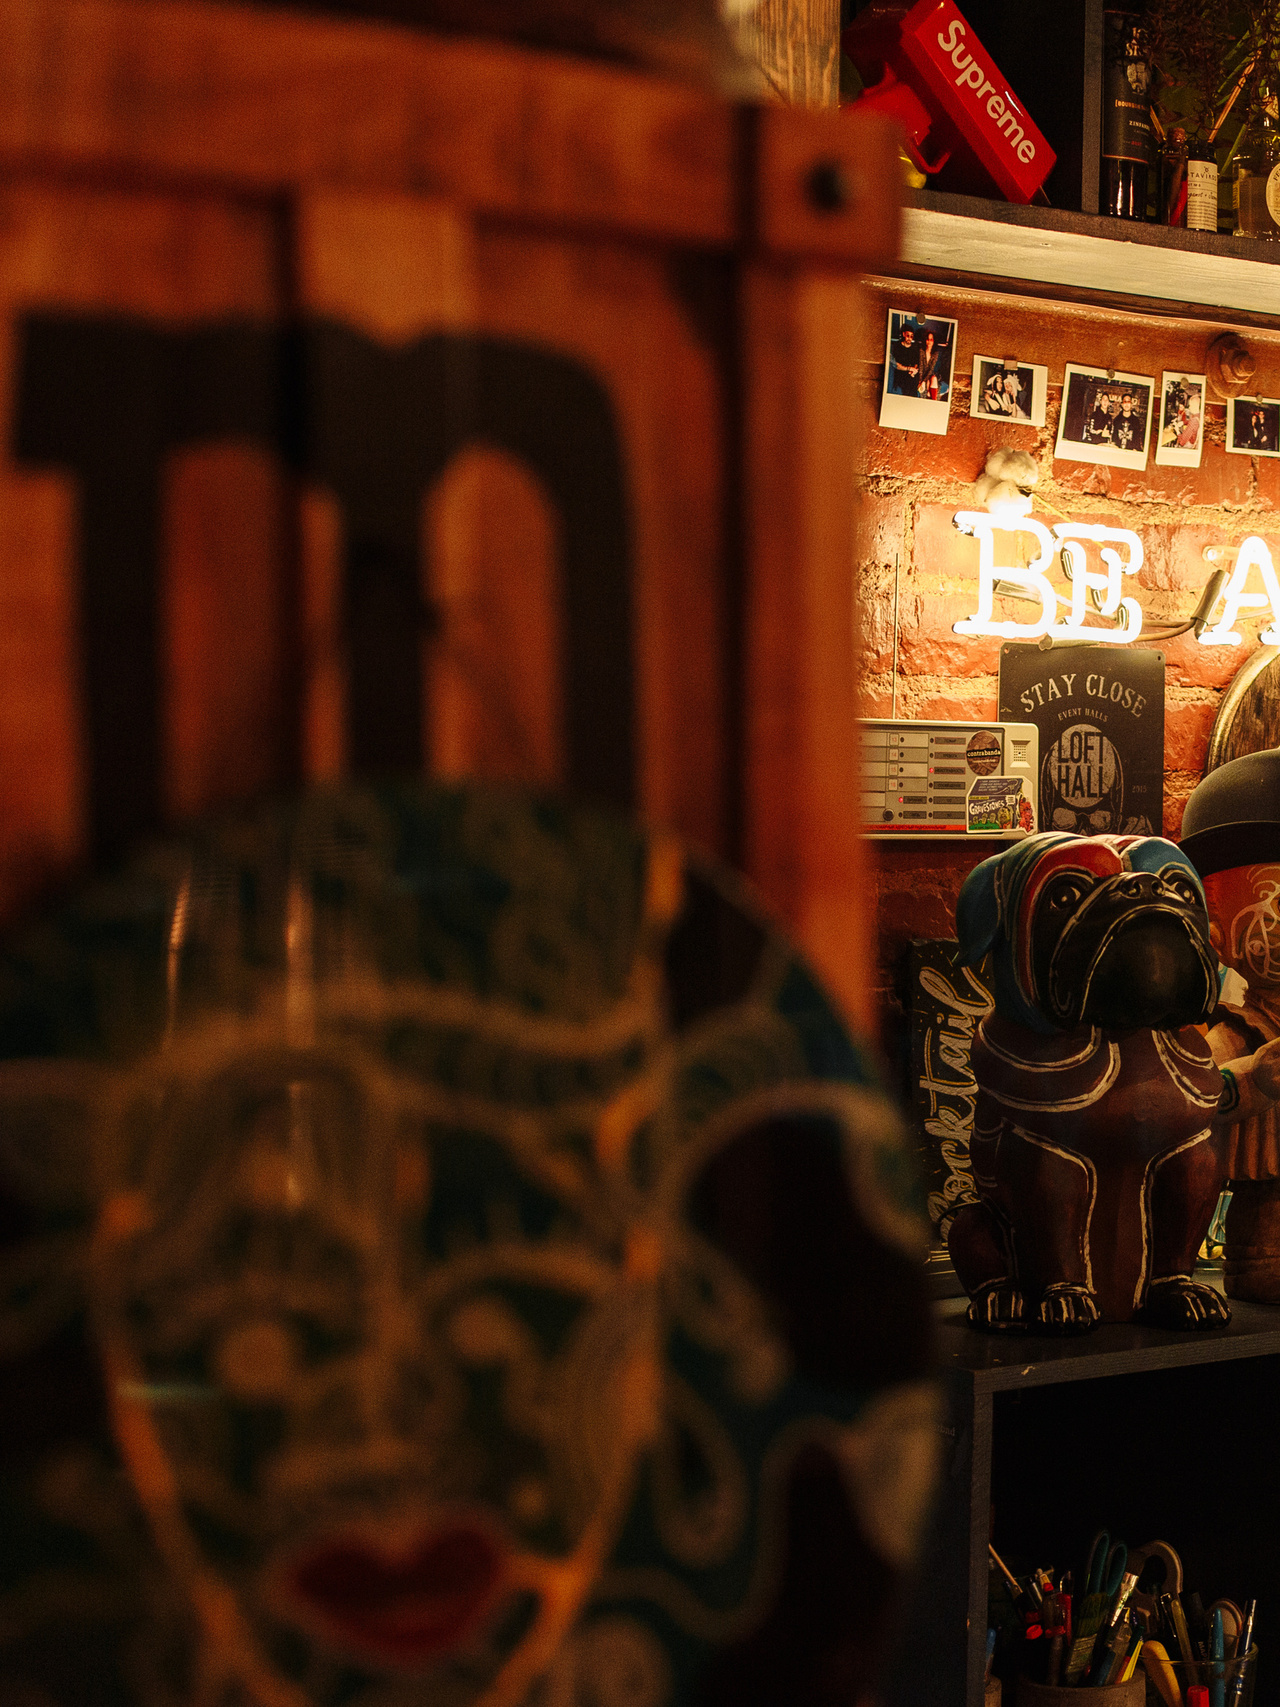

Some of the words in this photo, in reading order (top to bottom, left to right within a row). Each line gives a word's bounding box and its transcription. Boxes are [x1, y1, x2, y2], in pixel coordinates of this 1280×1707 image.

[937, 19, 1036, 165] Supreme
[953, 510, 1144, 642] BE
[1020, 673, 1077, 713] STAY
[1085, 674, 1147, 718] CLOSE
[1057, 707, 1083, 722] EVENT
[1084, 707, 1109, 723] HALLS
[967, 748, 1001, 757] contrabanda
[1057, 731, 1103, 764] LOFT
[1057, 765, 1110, 799] HALL
